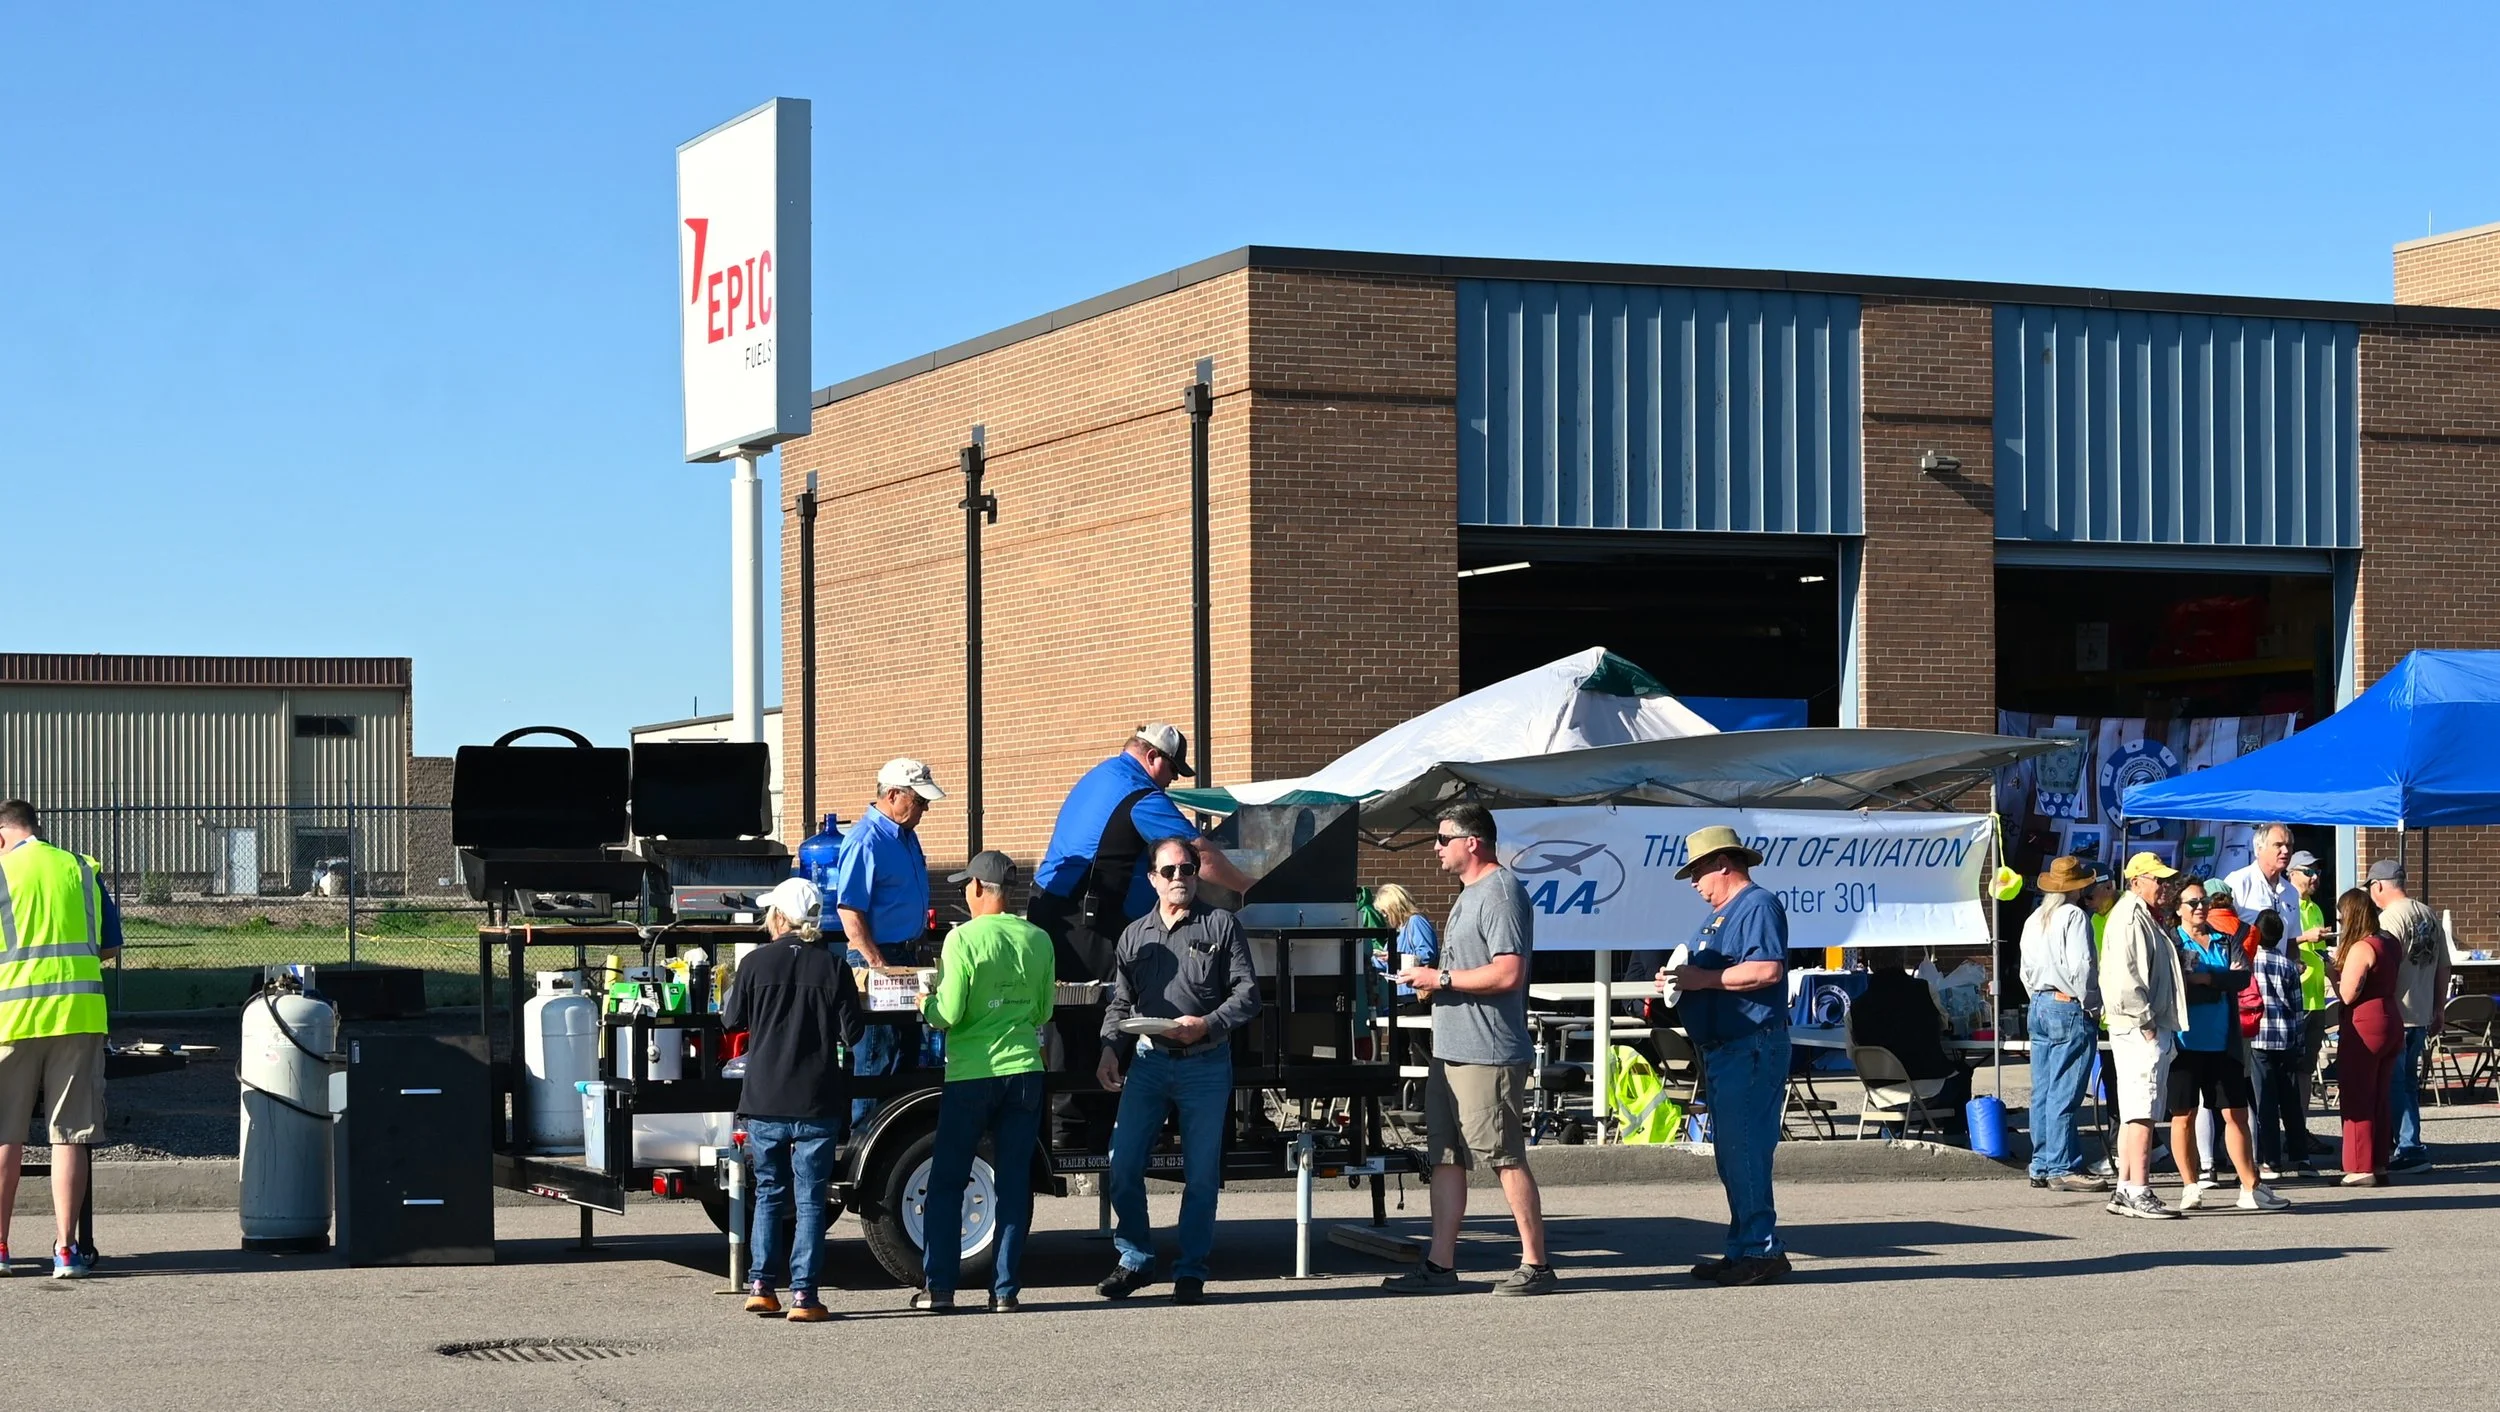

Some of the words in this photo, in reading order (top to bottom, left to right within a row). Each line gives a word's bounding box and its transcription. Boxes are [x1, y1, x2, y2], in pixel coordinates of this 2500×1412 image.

[707, 250, 772, 345] EPIC
[745, 338, 772, 370] FUELS
[1798, 837, 1841, 867] OF
[1835, 837, 1972, 867] AVIATION
[1519, 880, 1598, 915] AA
[1834, 882, 1879, 913] 301
[874, 978, 904, 987] BUTTER
[1058, 1158, 1087, 1169] TRAILER
